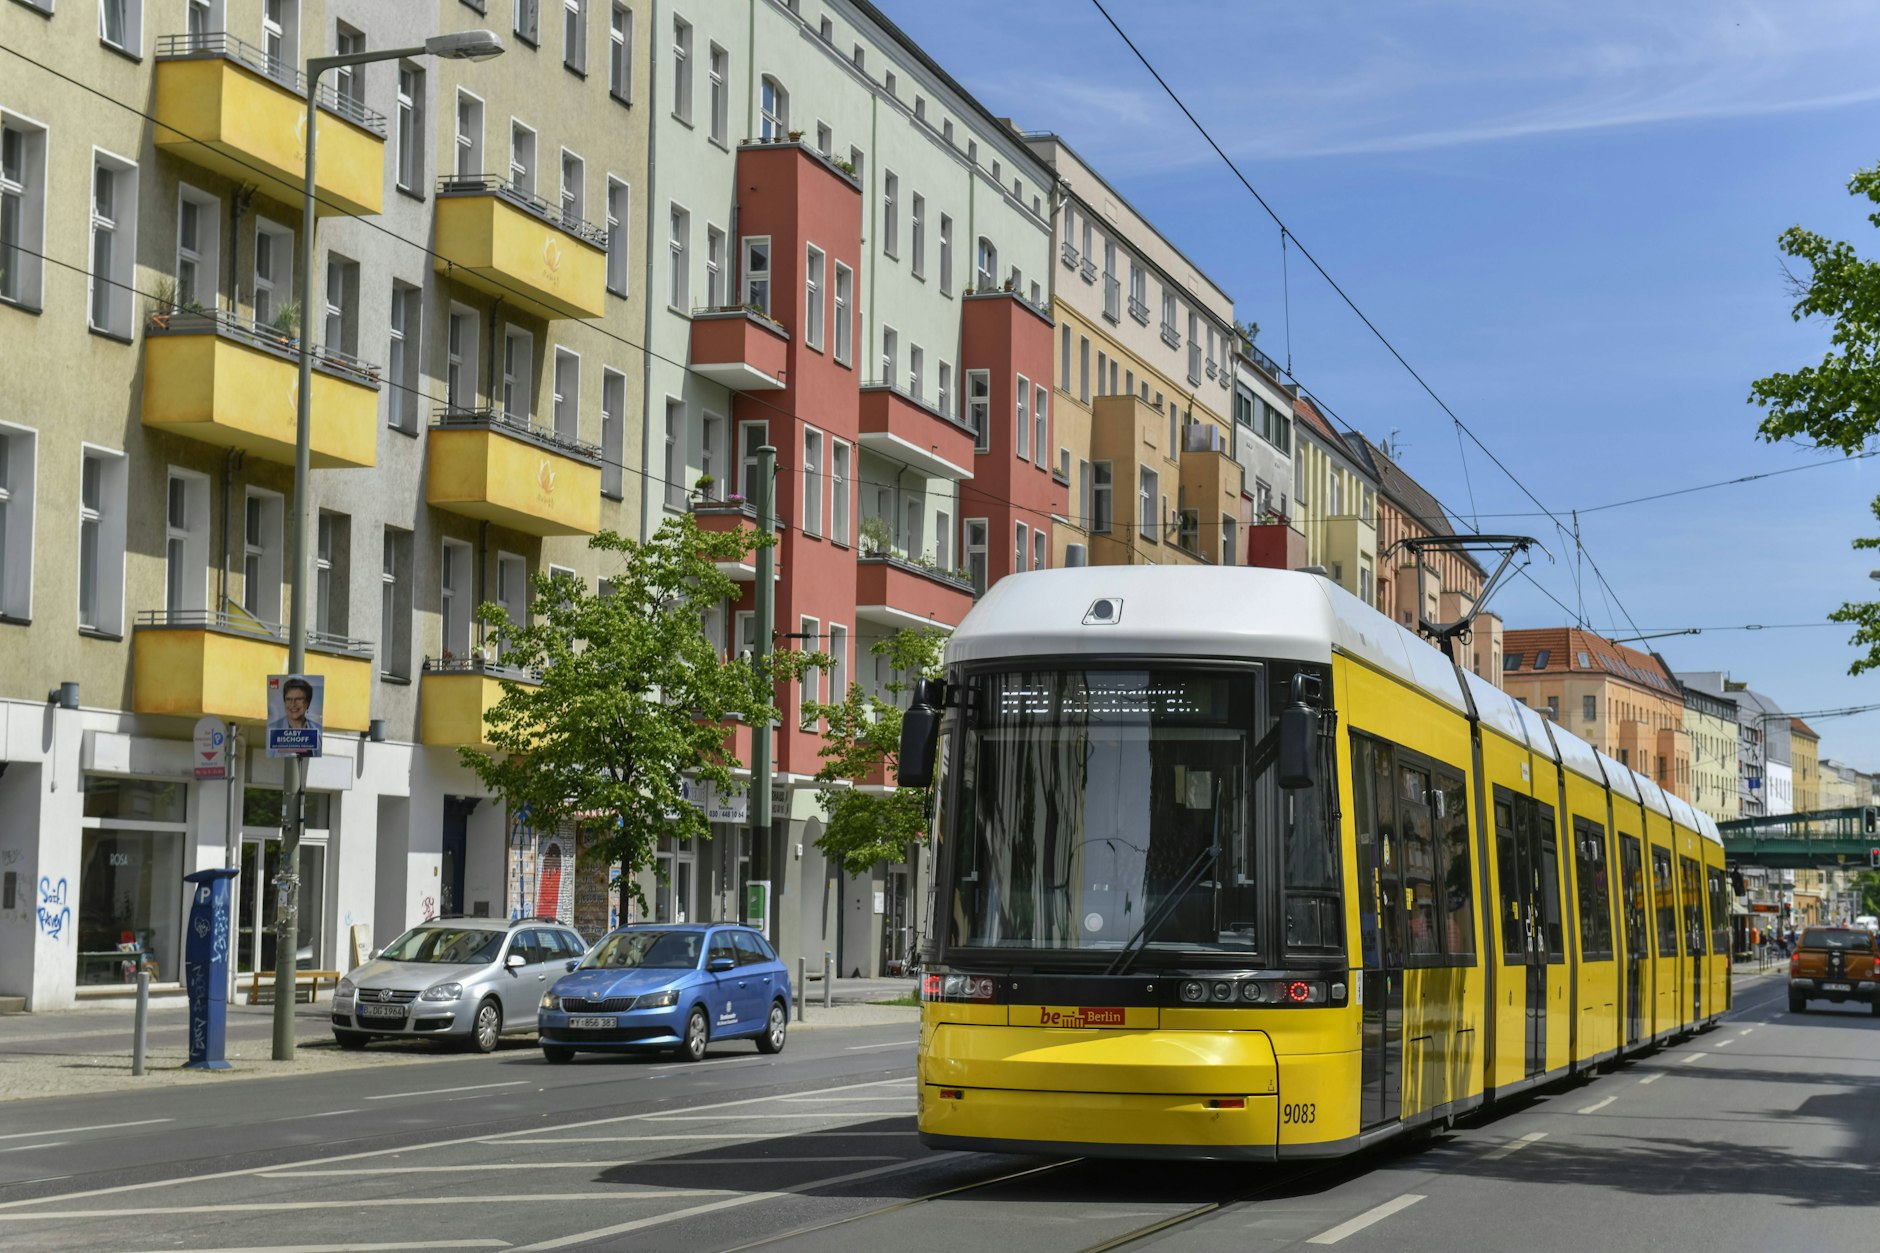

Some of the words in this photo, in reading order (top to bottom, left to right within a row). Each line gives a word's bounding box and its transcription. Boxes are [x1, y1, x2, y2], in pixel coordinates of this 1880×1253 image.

[709, 810, 718, 818] 030
[110, 854, 128, 866] ROSA
[200, 887, 211, 904] P
[1040, 1006, 1061, 1024] be
[1087, 1011, 1121, 1022] Berlin
[1283, 1103, 1316, 1124] 9083
